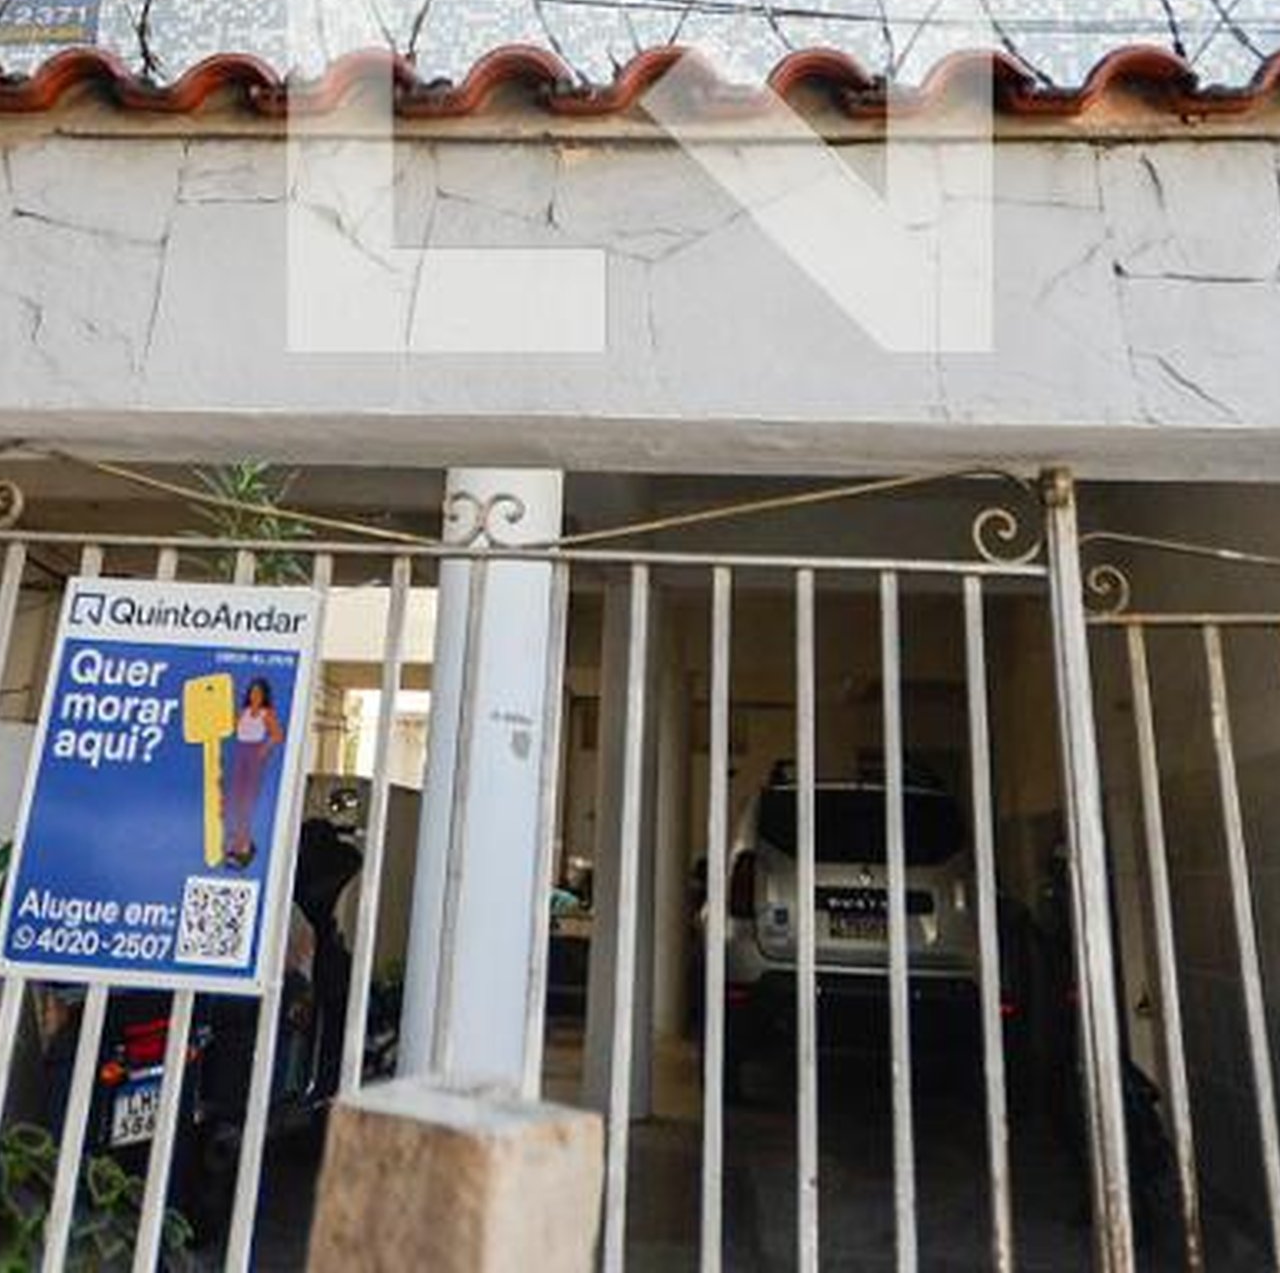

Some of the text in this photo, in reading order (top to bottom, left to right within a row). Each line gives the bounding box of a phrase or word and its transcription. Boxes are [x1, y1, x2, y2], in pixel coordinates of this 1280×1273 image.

[109, 596, 308, 635] QuintoAndar
[69, 648, 168, 686] Quer
[60, 691, 179, 727] morar
[53, 726, 164, 767] aqui?
[18, 888, 179, 927] Alugue em:
[36, 929, 174, 960] 4020-2507
